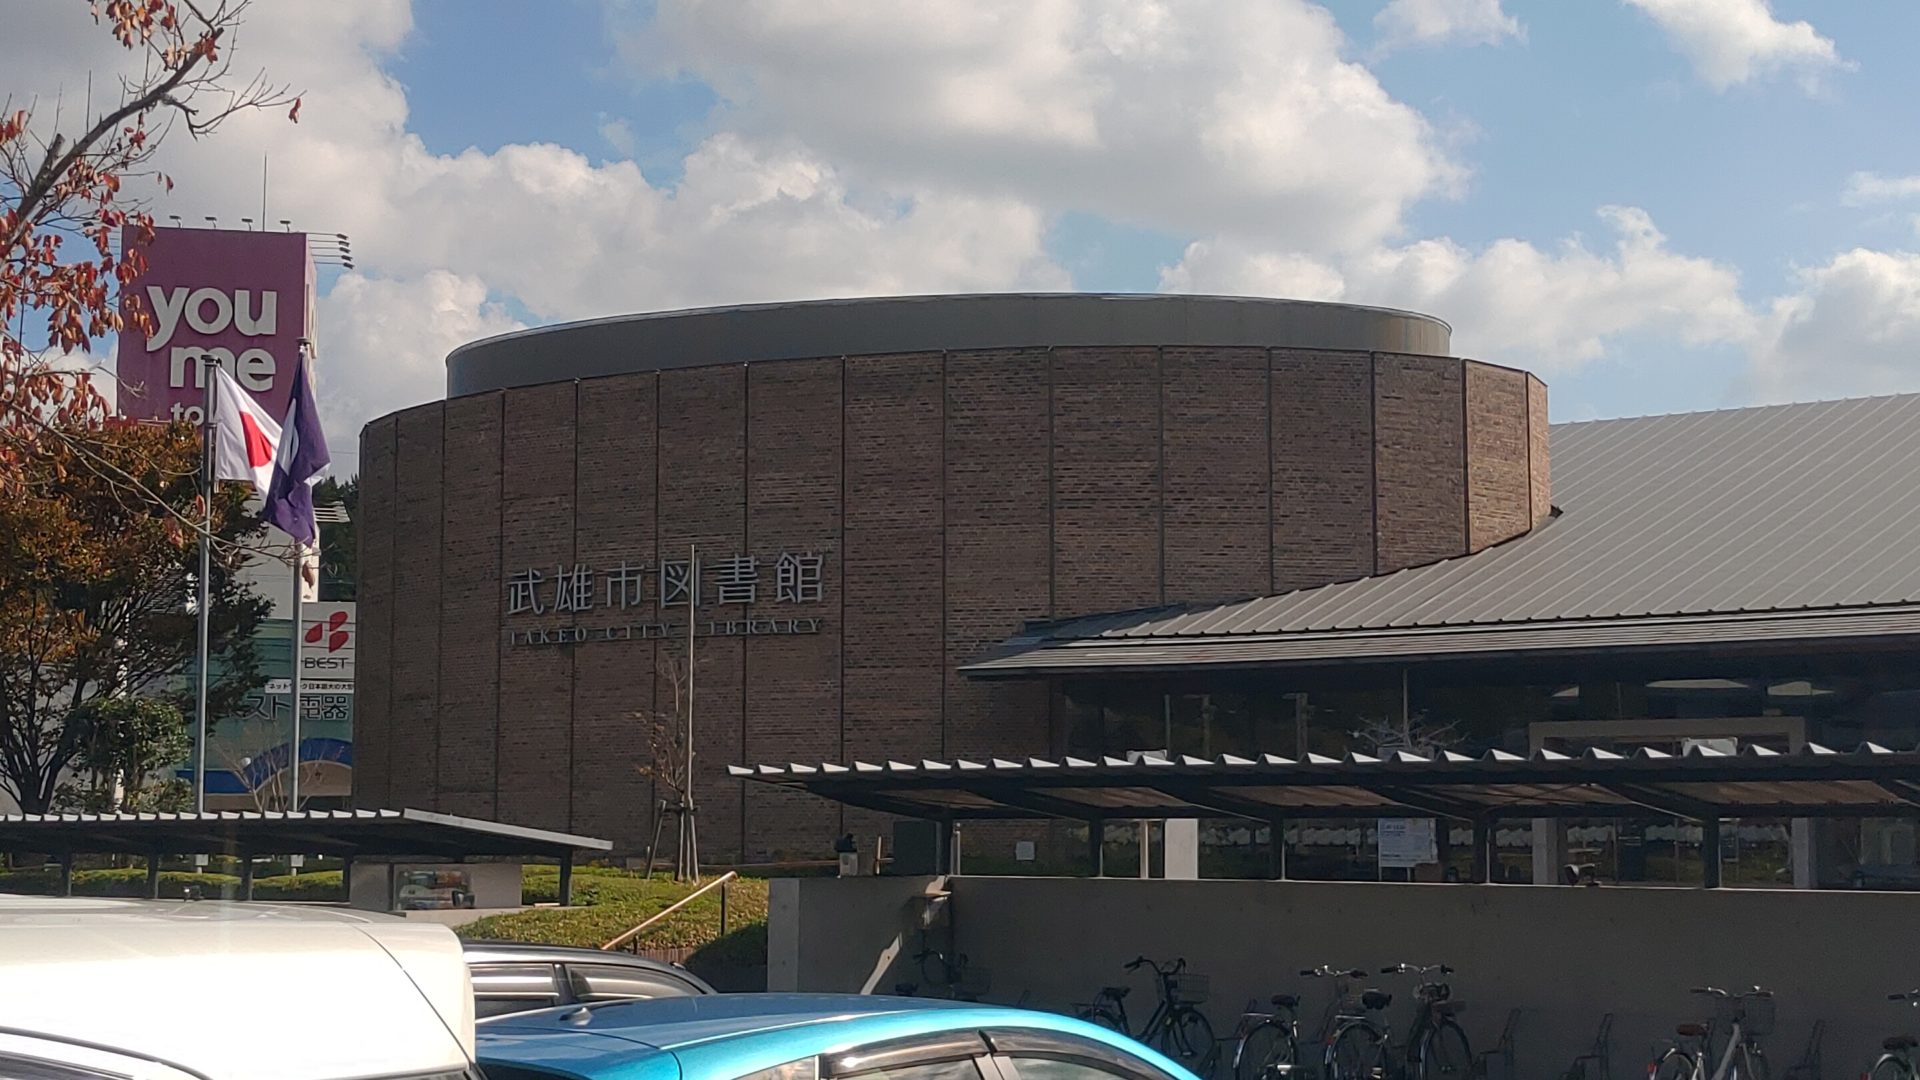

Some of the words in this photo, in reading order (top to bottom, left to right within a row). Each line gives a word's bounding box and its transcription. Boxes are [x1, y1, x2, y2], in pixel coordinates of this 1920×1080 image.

[146, 286, 277, 352] you
[169, 346, 276, 392] me
[507, 552, 824, 615] 武雄市図書館
[511, 626, 588, 645] TAKEO
[606, 624, 671, 640] CITY
[690, 618, 821, 635] IBRARY
[304, 657, 349, 669] BEST
